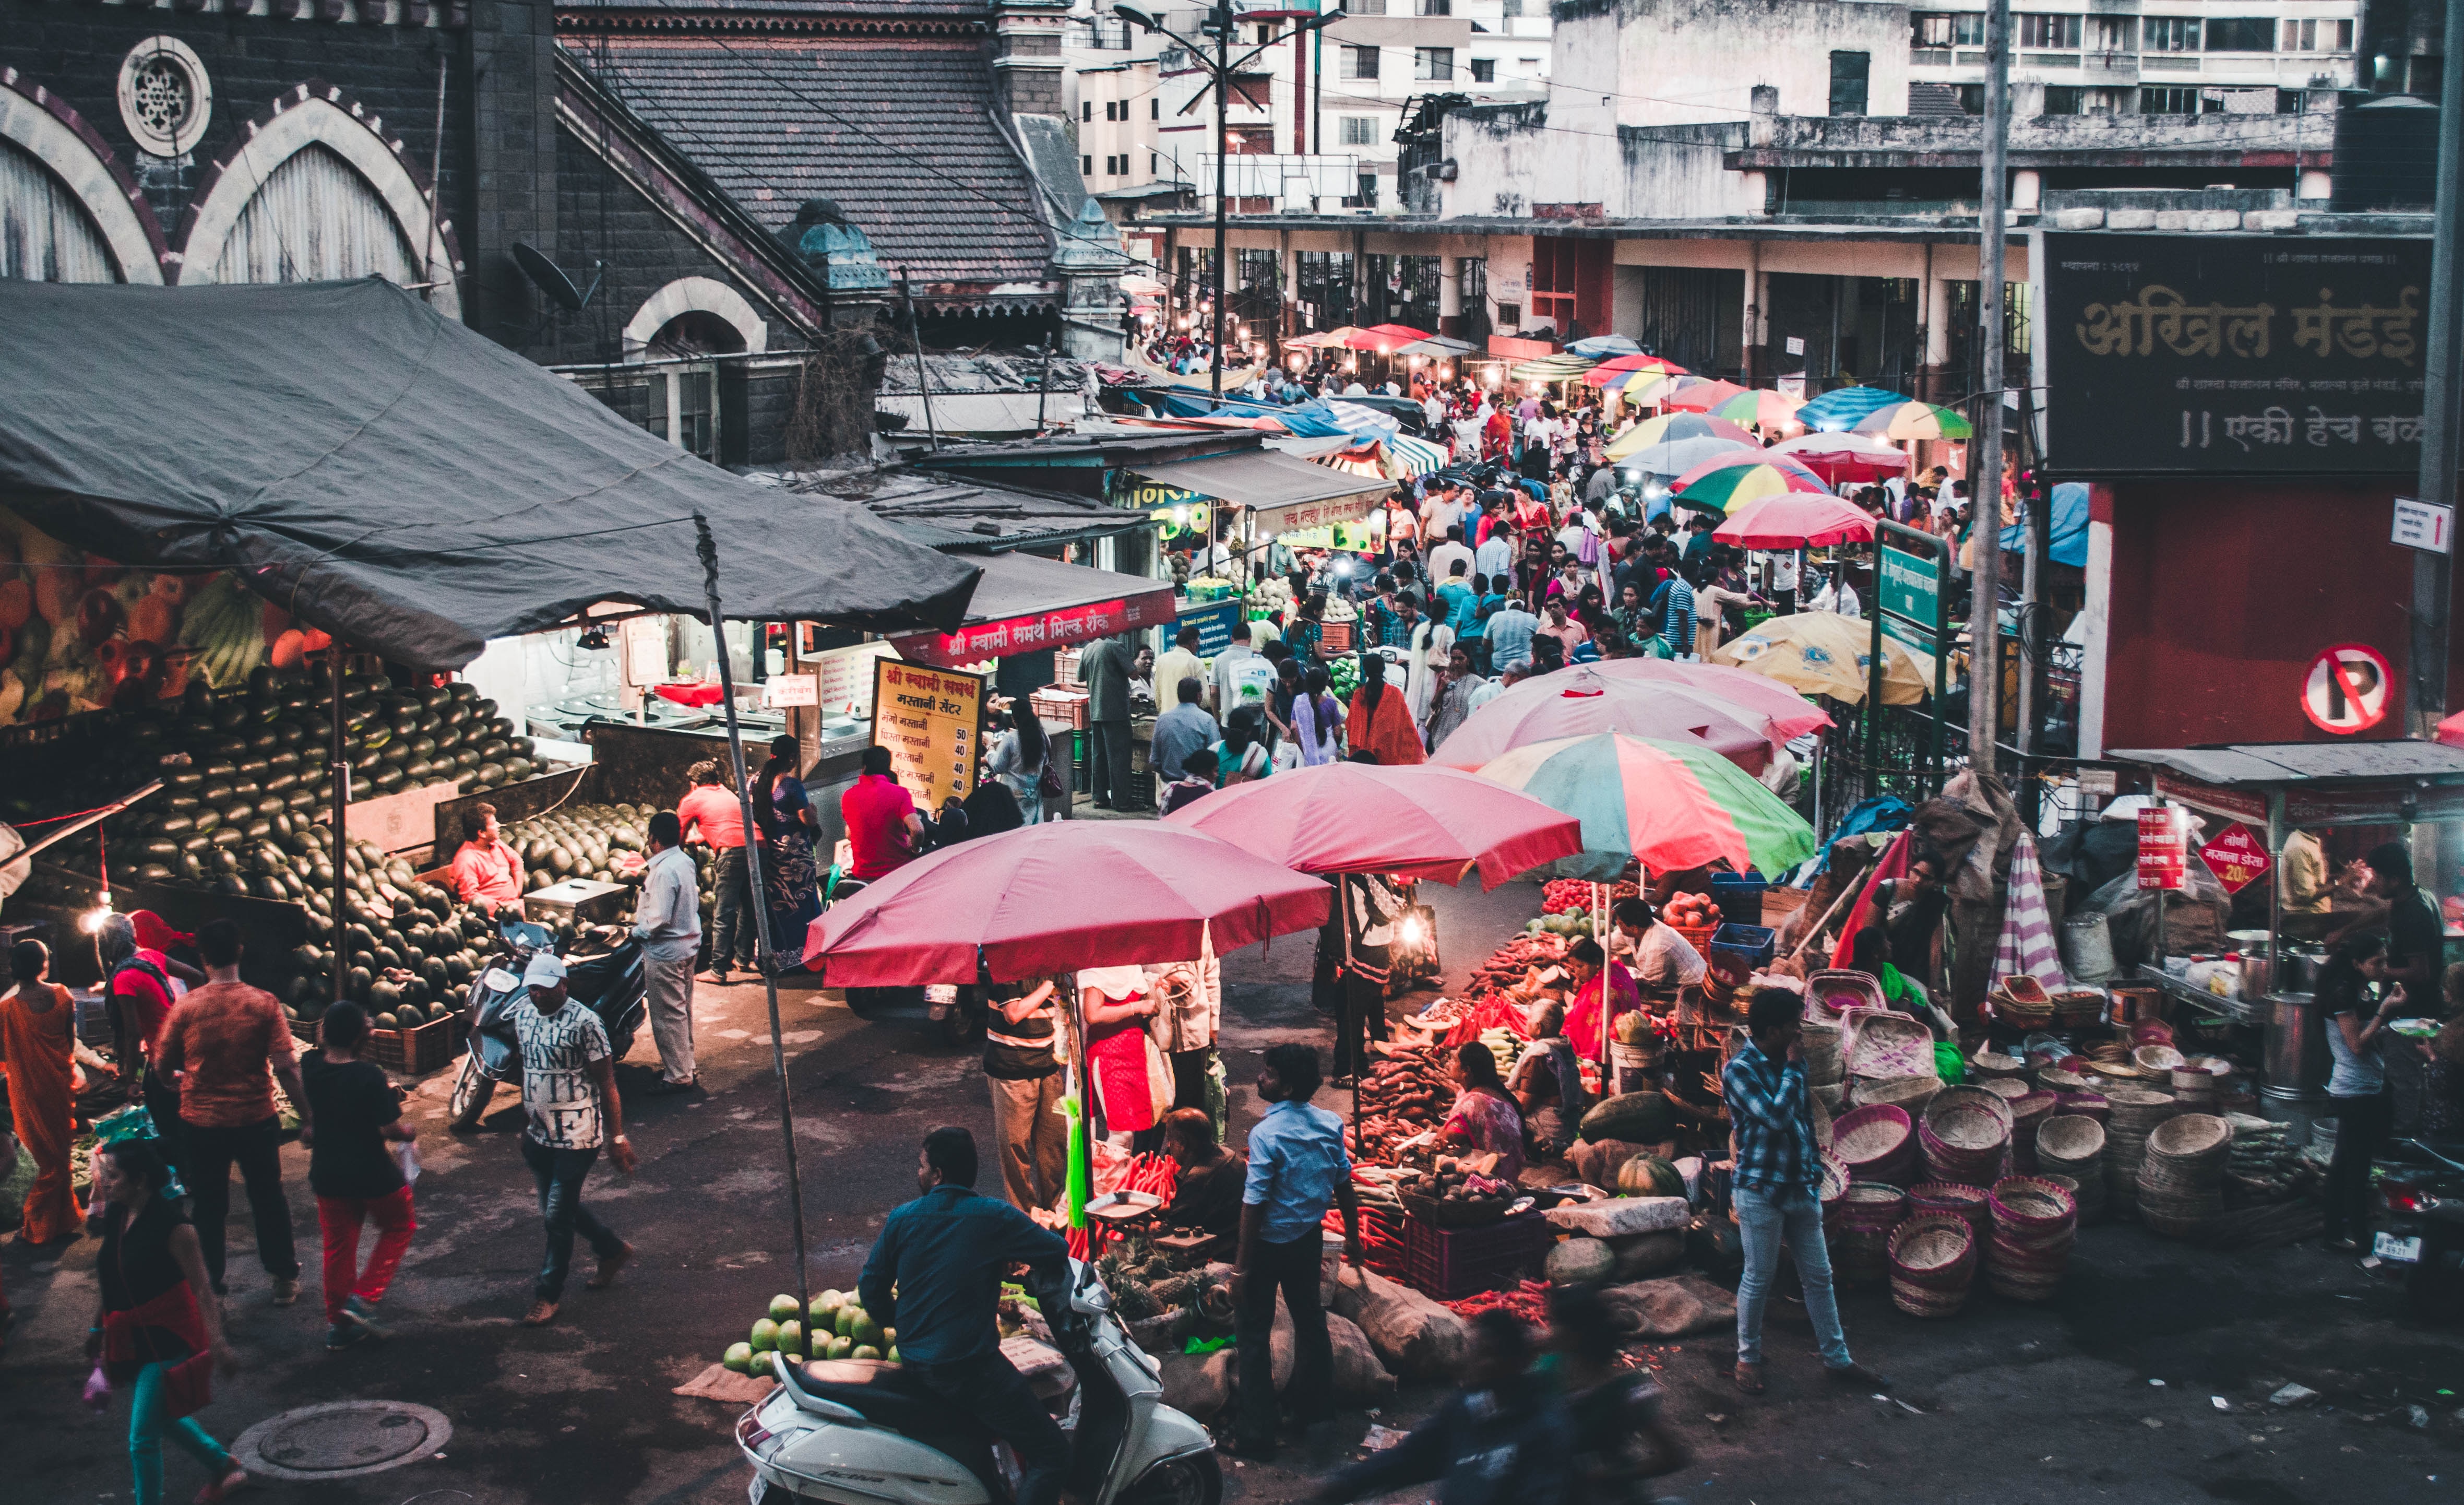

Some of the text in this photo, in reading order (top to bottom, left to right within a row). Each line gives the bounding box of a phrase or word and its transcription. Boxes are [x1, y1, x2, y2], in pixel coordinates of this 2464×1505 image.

[2075, 285, 2419, 366] अखिल मंडई
[2224, 406, 2293, 452] एकी
[2304, 406, 2360, 448] हेच
[948, 632, 966, 656] श्री
[970, 624, 1008, 652] स्वामी
[1013, 618, 1046, 645] समर्थ
[1050, 616, 1083, 639] मिल्क
[1086, 609, 1109, 633] शेक
[887, 666, 902, 685] श्री
[906, 673, 941, 692] स्वामी
[944, 680, 976, 698] समर्थ
[897, 694, 935, 710] मस्तानी
[900, 718, 927, 731] मस्तानी
[881, 728, 900, 742] पिस्ता
[902, 736, 930, 748] मस्तानी
[896, 752, 923, 764] मस्तानी
[907, 772, 934, 784] मस्तानी
[908, 788, 931, 801] स्तानी
[2223, 832, 2248, 848] लोणी
[2205, 848, 2264, 868] मसाला डोसा
[820, 1470, 886, 1483] Activa
